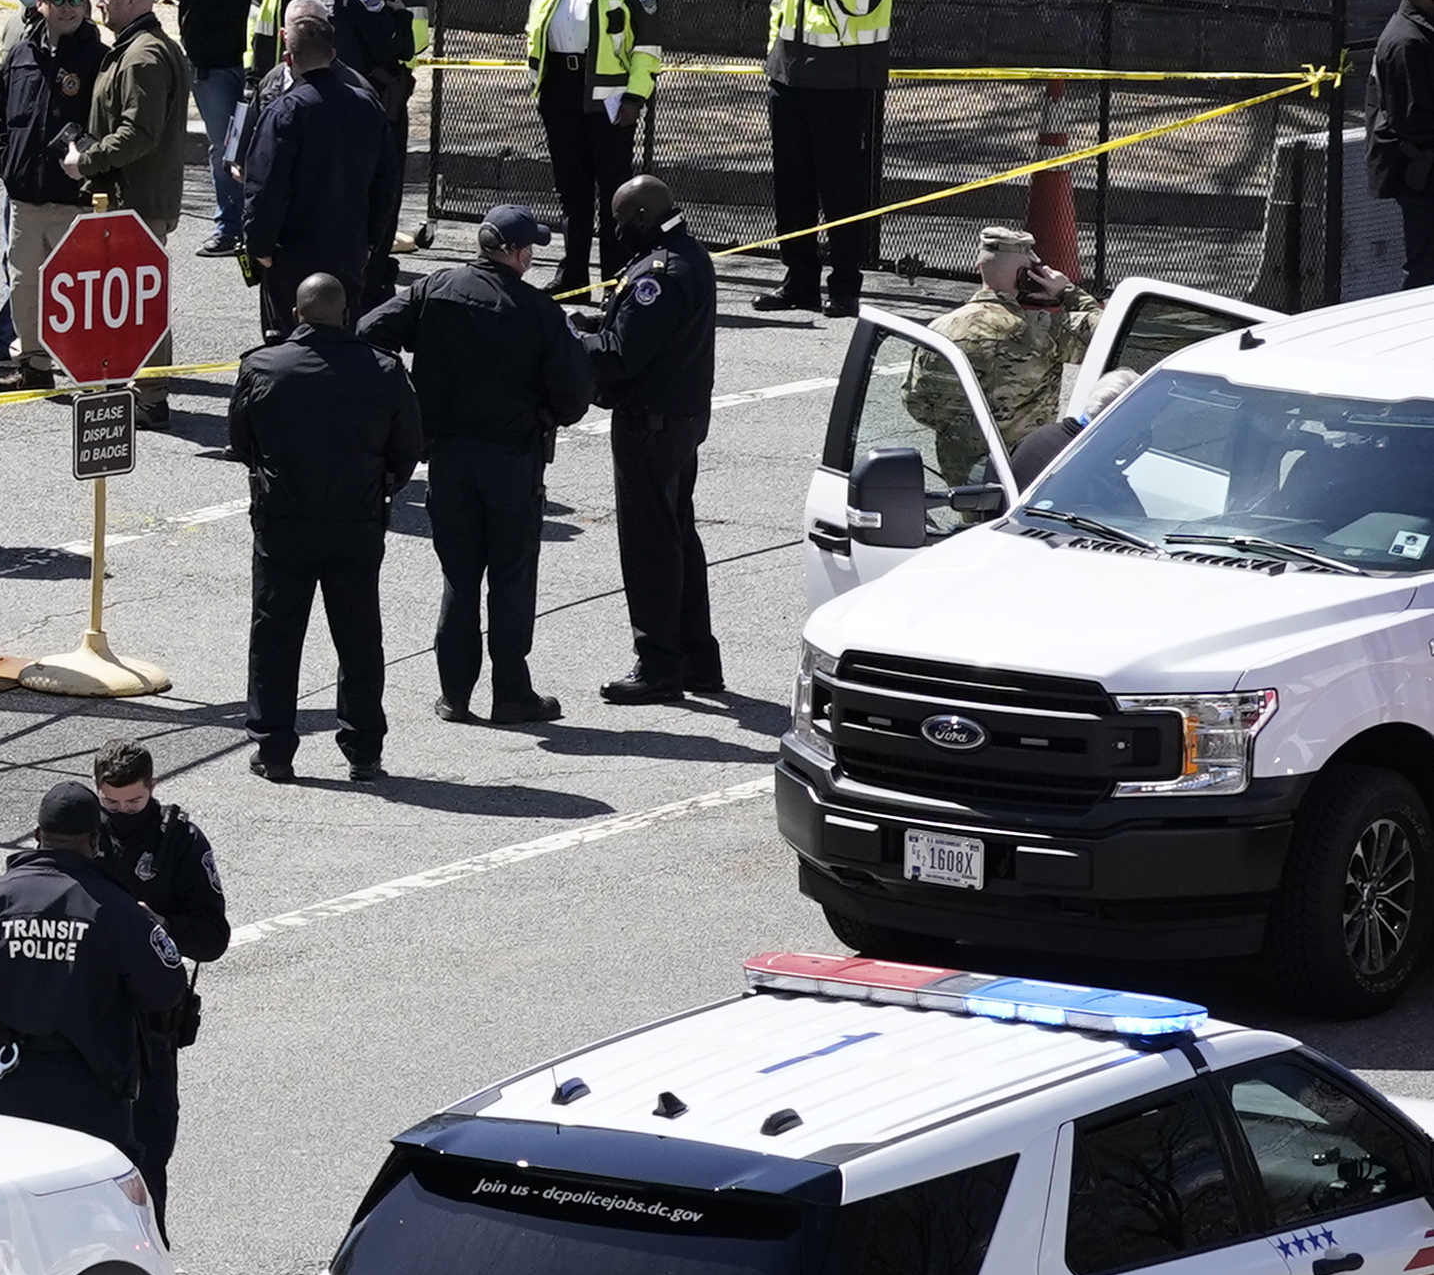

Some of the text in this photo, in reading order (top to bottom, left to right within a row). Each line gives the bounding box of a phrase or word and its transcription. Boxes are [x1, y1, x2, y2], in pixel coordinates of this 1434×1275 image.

[48, 265, 162, 333] STOP
[84, 405, 124, 423] PLEASE
[82, 425, 125, 443] DISPLAY
[80, 444, 128, 463] ID BADGE
[934, 723, 969, 743] Ford
[930, 846, 972, 875] 1608X
[2, 919, 89, 941] TRANSIT
[8, 939, 77, 962] POLICE
[472, 1177, 507, 1196] Join
[509, 1184, 529, 1197] us
[542, 1185, 703, 1224] dcpolicejobs.dc.gov
